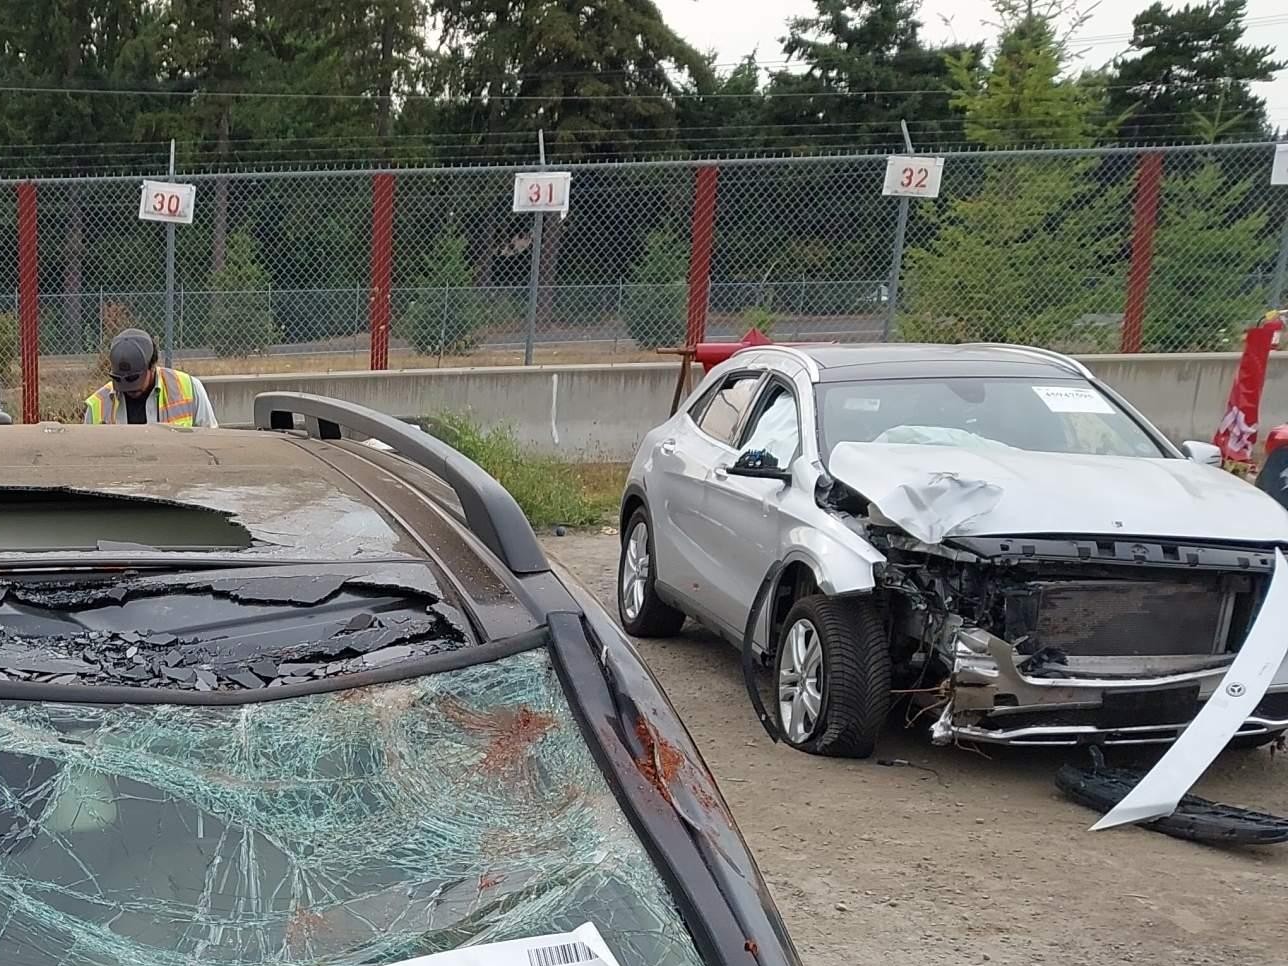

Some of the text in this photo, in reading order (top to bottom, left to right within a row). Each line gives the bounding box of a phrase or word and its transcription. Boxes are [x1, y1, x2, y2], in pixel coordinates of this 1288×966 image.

[900, 167, 929, 188] 32
[152, 191, 181, 214] 30
[528, 182, 554, 203] 31
